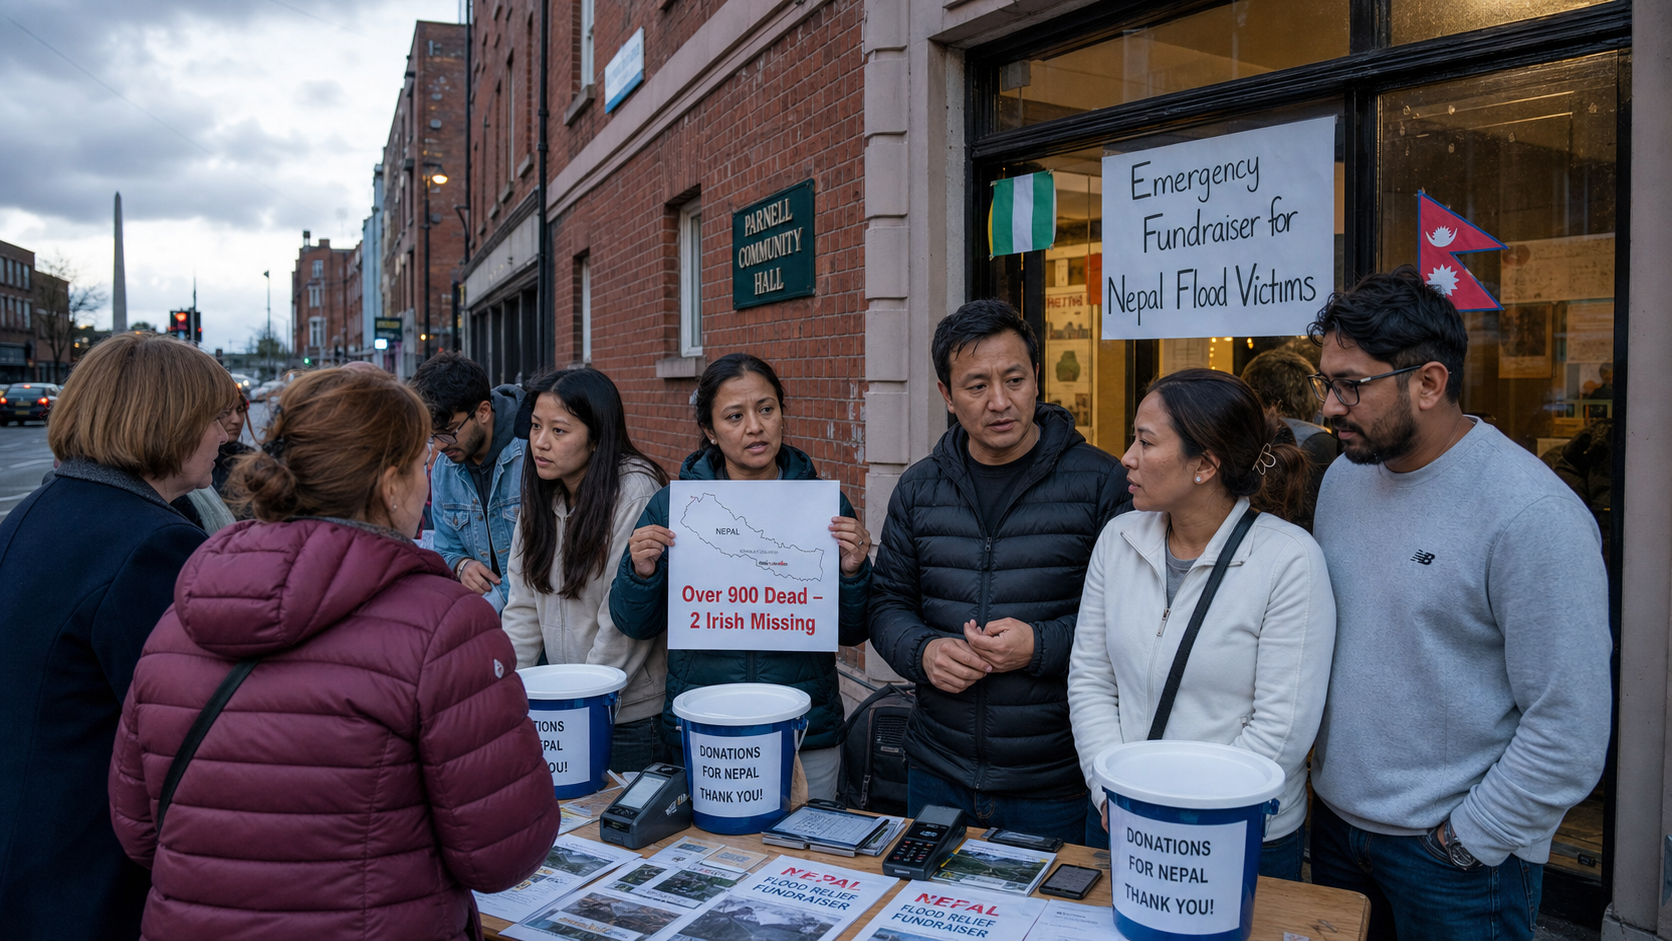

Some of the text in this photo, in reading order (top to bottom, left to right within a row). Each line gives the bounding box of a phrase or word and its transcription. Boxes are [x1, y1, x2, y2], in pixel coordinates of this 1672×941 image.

[1131, 156, 1260, 203] Emergency
[744, 198, 793, 237] PARNELL
[1143, 196, 1298, 253] Fundraiser for
[738, 227, 803, 269] COMMUNITY
[754, 267, 784, 295] HALL
[1108, 263, 1316, 326] Nepal Flood Victims
[715, 527, 740, 536] NEPAL
[682, 585, 723, 603] Over
[728, 586, 759, 604] 900
[764, 586, 808, 605] Dead
[690, 611, 816, 636] 2 Irish Missing
[700, 744, 761, 760] DONATIONS
[548, 761, 568, 773] OU!
[702, 765, 760, 780] FOR NEPAL
[700, 787, 763, 803] THANK YOU!
[1126, 826, 1211, 857] DONATIONS
[780, 867, 861, 892] NEPAL
[1129, 854, 1209, 884] FOR NEPAL
[752, 884, 851, 911] FUNDRAISER
[763, 876, 859, 901] FLOOD RELIEF
[1124, 882, 1171, 913] THANK
[1175, 898, 1214, 915] YOU!
[900, 904, 996, 928] FLOOD RELIEF
[914, 892, 999, 917] NEPAL
[891, 912, 989, 938] FUNDRAISER
